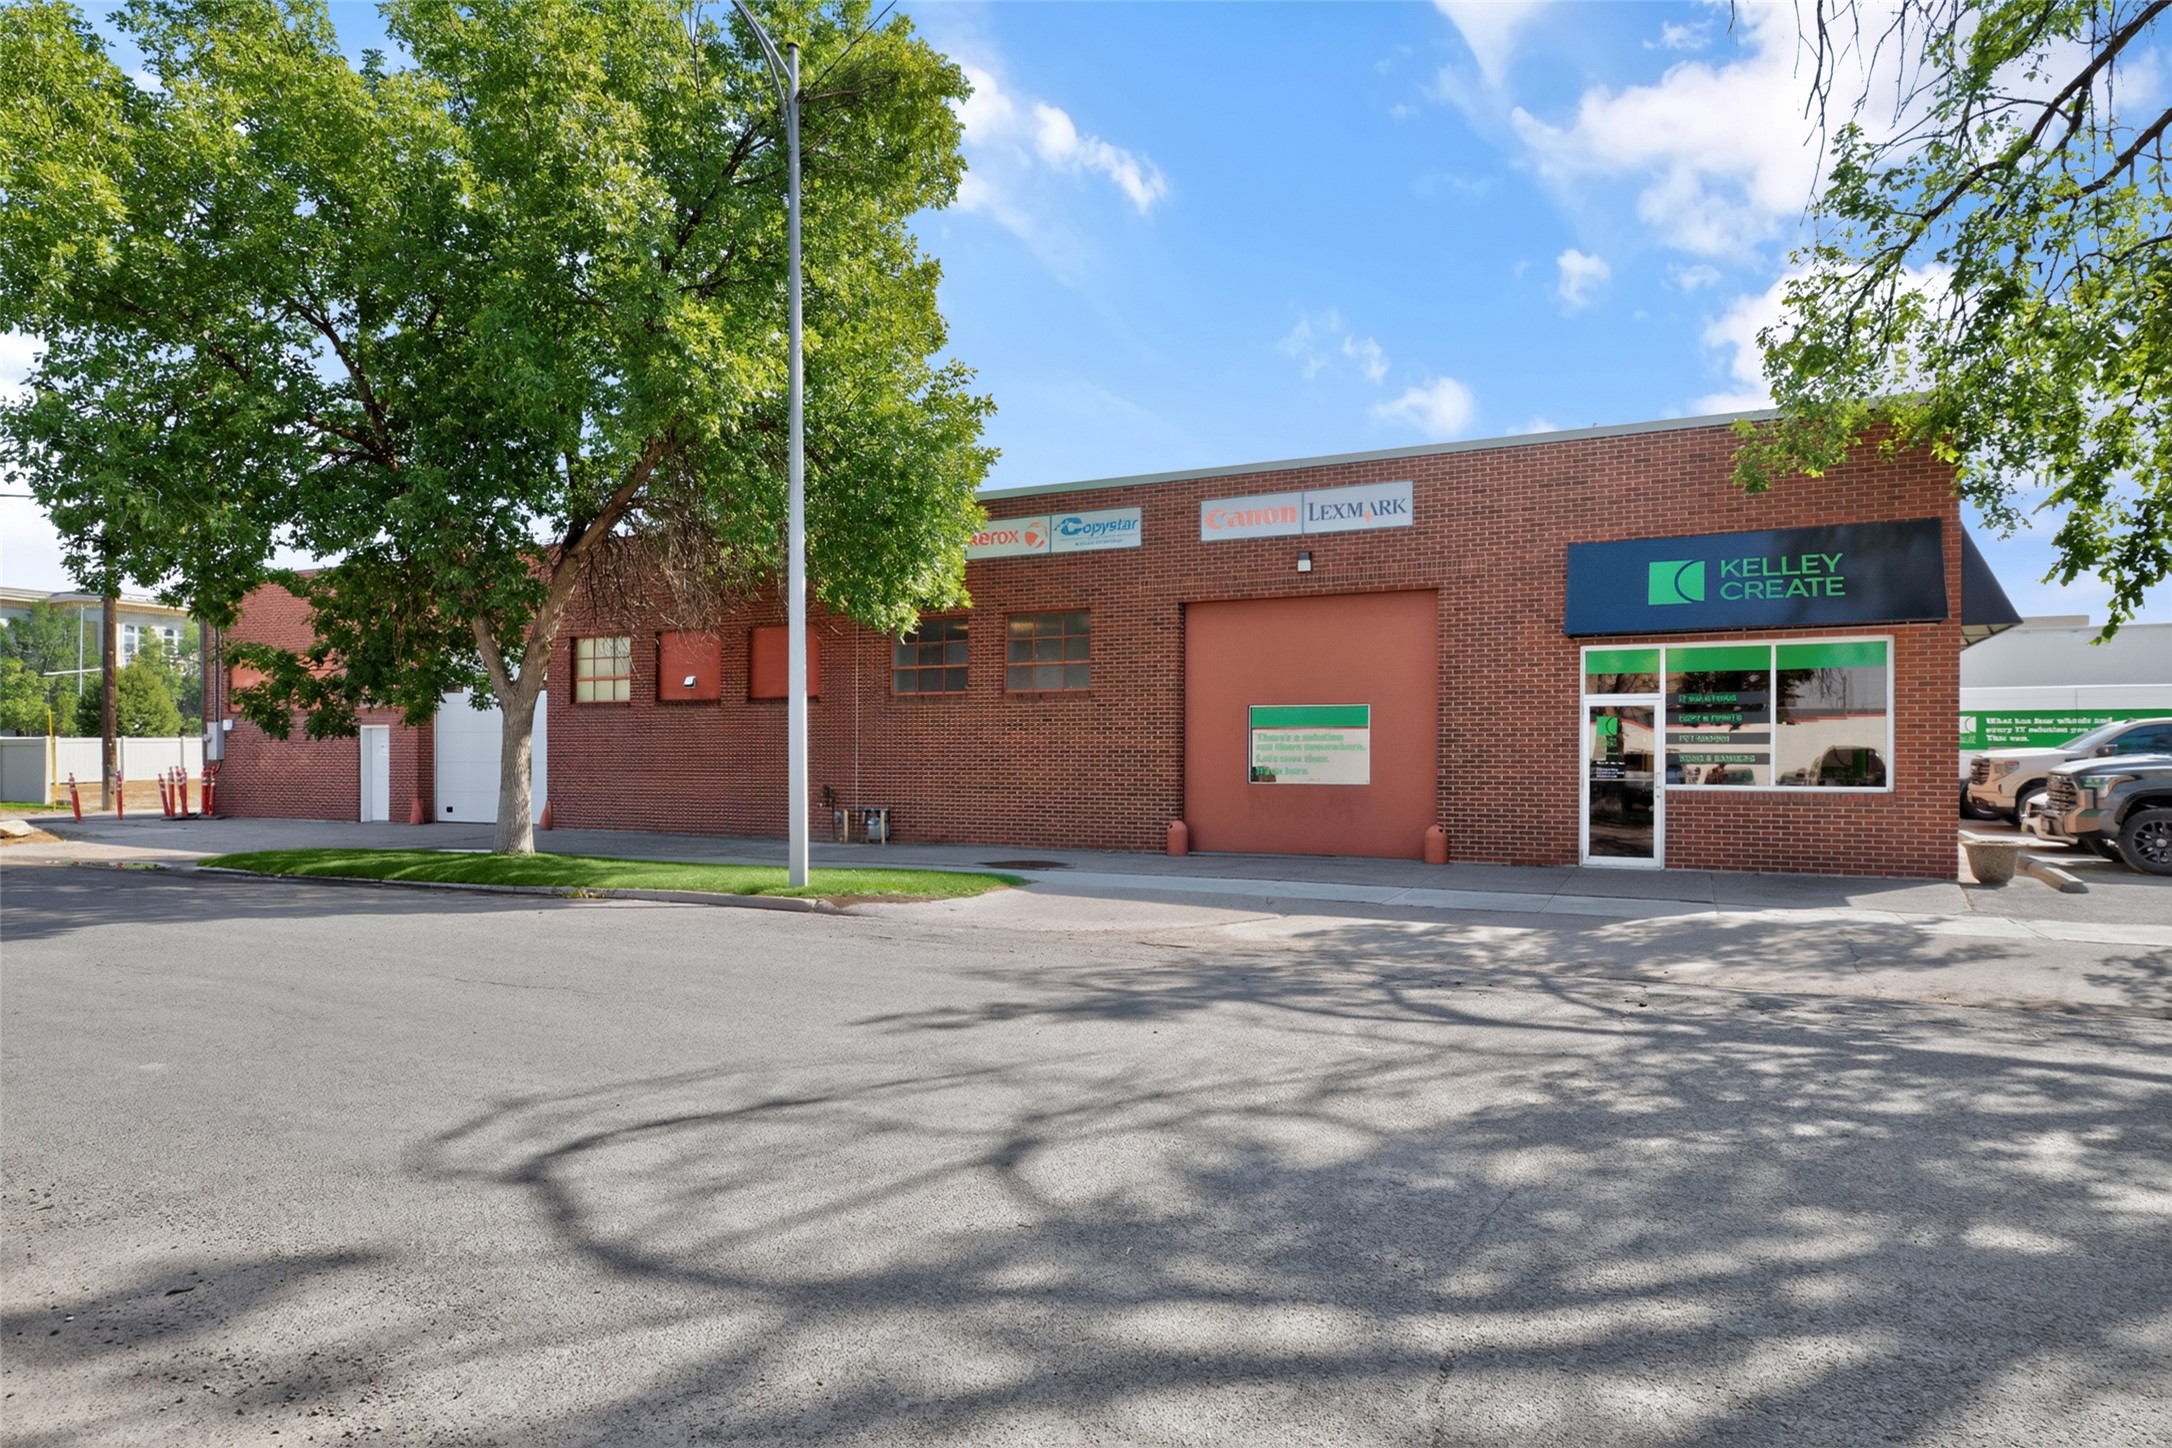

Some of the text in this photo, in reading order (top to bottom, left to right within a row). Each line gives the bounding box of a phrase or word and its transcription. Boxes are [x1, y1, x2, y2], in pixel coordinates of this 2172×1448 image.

[1205, 504, 1297, 530] Canon
[1308, 498, 1407, 522] LEXMARK
[1060, 517, 1139, 536] Copystar
[1720, 552, 1843, 578] KELLEY
[1720, 576, 1846, 600] CREATE
